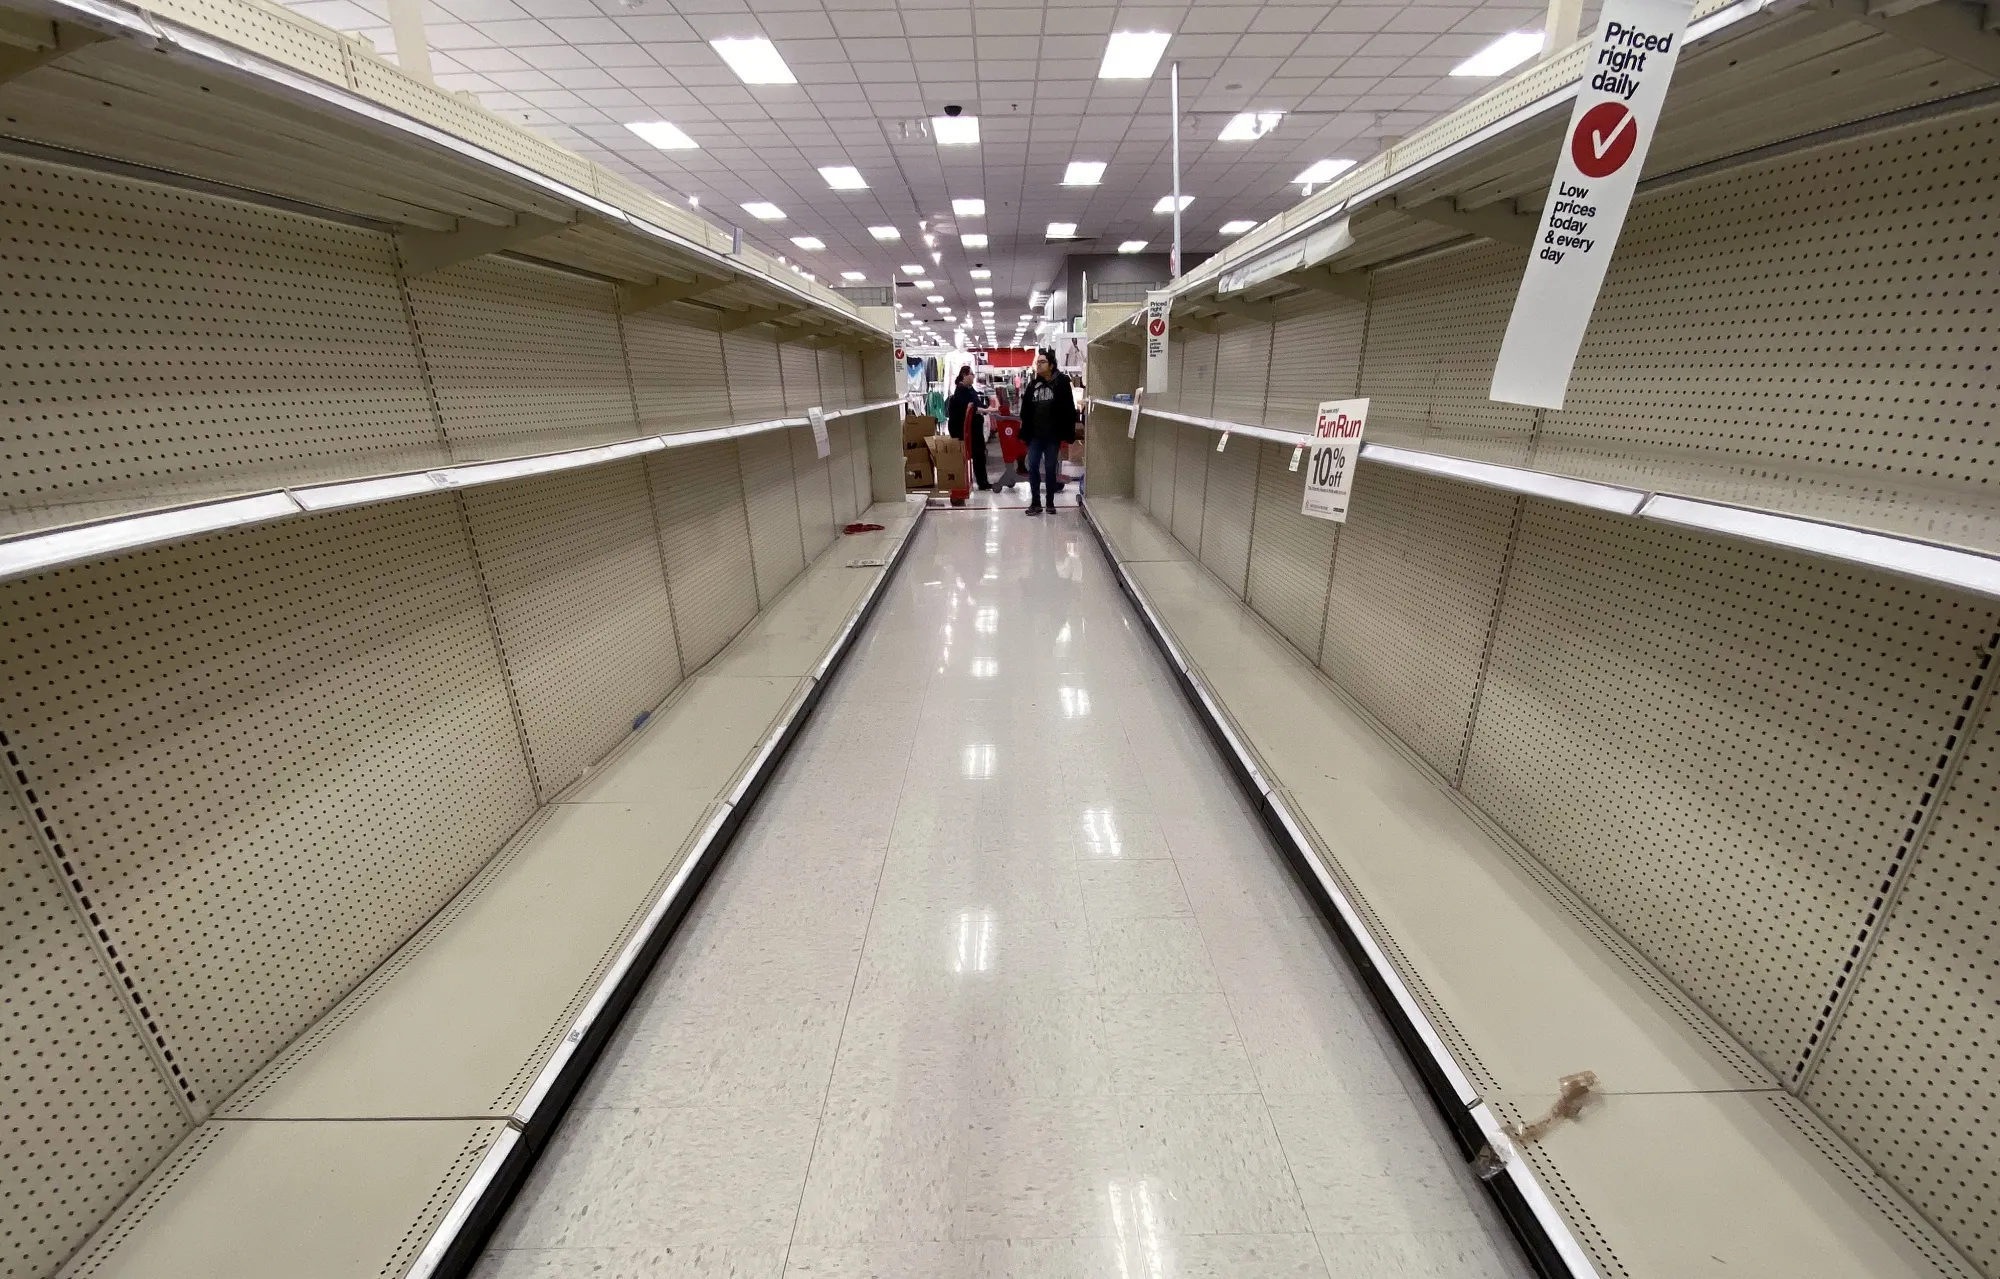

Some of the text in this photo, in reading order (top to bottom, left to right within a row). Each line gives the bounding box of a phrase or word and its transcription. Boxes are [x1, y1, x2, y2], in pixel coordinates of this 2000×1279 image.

[1604, 21, 1673, 53] Priced
[1597, 45, 1646, 73] right
[1591, 70, 1640, 100] daily
[1559, 181, 1589, 199] Low
[1552, 200, 1597, 217] prices
[1549, 216, 1588, 235] today
[1544, 230, 1595, 253] & every
[1540, 246, 1565, 264] day
[1316, 414, 1361, 438] FunRun
[1312, 447, 1345, 486] 10%
[1328, 471, 1342, 487] off
